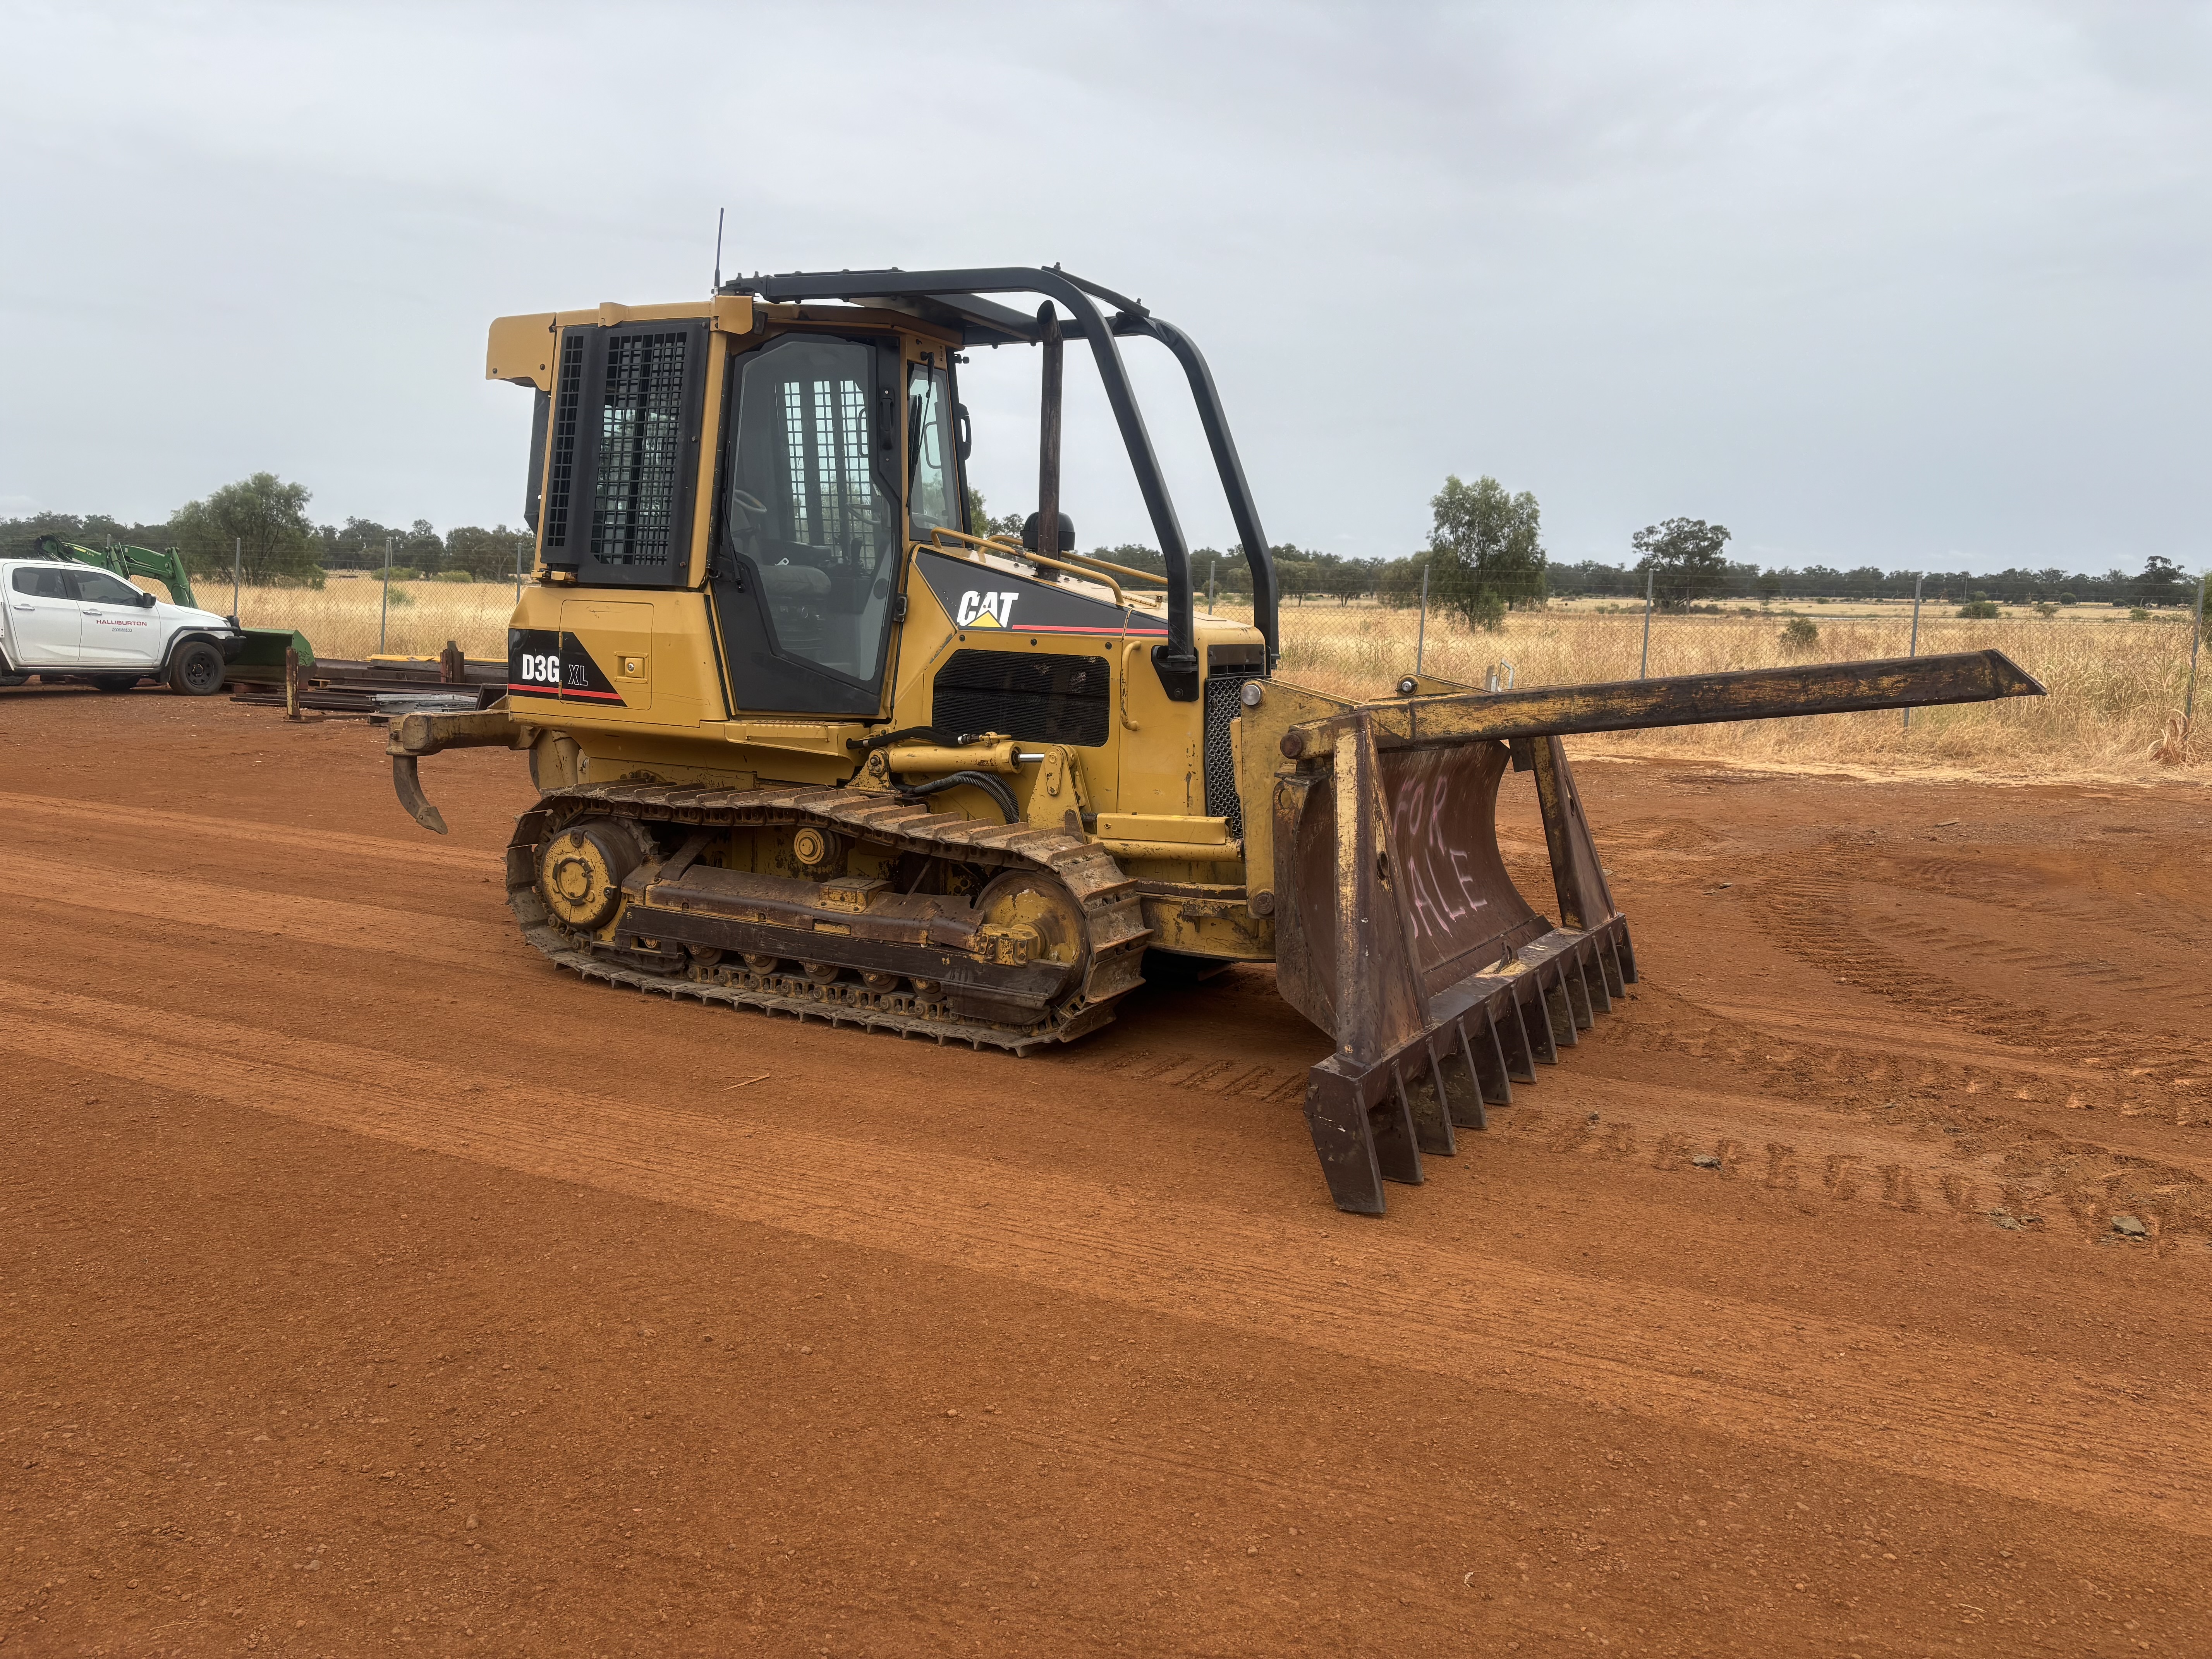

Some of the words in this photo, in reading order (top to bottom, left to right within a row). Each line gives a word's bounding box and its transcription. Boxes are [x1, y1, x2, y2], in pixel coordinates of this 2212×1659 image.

[957, 591, 1019, 628] CAT
[522, 654, 560, 682] D3G
[568, 664, 588, 686] XL
[1394, 776, 1448, 856] FOR
[1410, 848, 1487, 938] ALE
